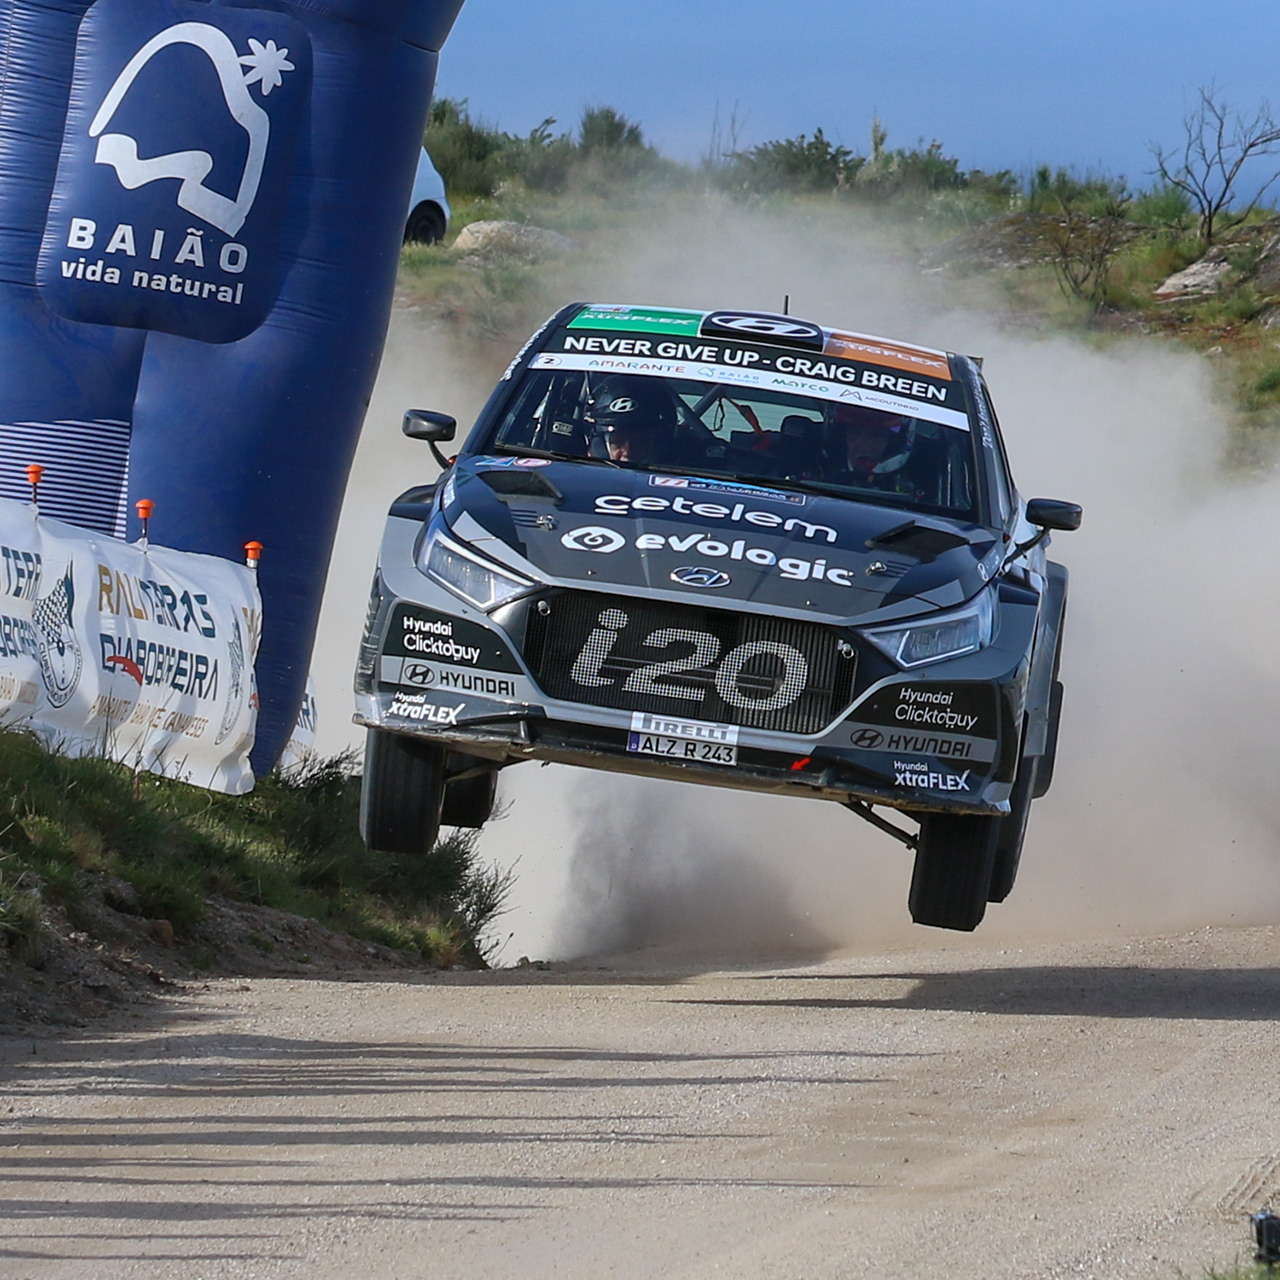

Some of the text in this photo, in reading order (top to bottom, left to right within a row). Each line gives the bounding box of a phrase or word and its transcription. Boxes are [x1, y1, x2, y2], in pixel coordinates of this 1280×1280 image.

[67, 217, 249, 274] BAIÃO
[60, 257, 244, 305] vida natural
[563, 336, 652, 356] NEVER
[656, 342, 719, 362] GIVE
[723, 348, 760, 366] UP
[775, 356, 856, 383] CRAIG
[861, 372, 948, 401] BREEN
[588, 359, 686, 374] AMARANTE
[593, 495, 840, 543] cetelem
[634, 532, 854, 587] evologic
[402, 616, 453, 637] Hyundai
[570, 608, 808, 711] i20
[394, 690, 427, 704] Hyundai
[439, 670, 516, 697] HYUNDAI
[899, 687, 954, 706] Hyundai
[388, 701, 466, 726] xtraFLEX
[642, 713, 730, 741] PIRELLI
[641, 736, 734, 763] ALZ R 243
[887, 734, 972, 758] HYUNDAI
[894, 760, 929, 771] Hyundai
[894, 769, 971, 792] xtraFLEX
